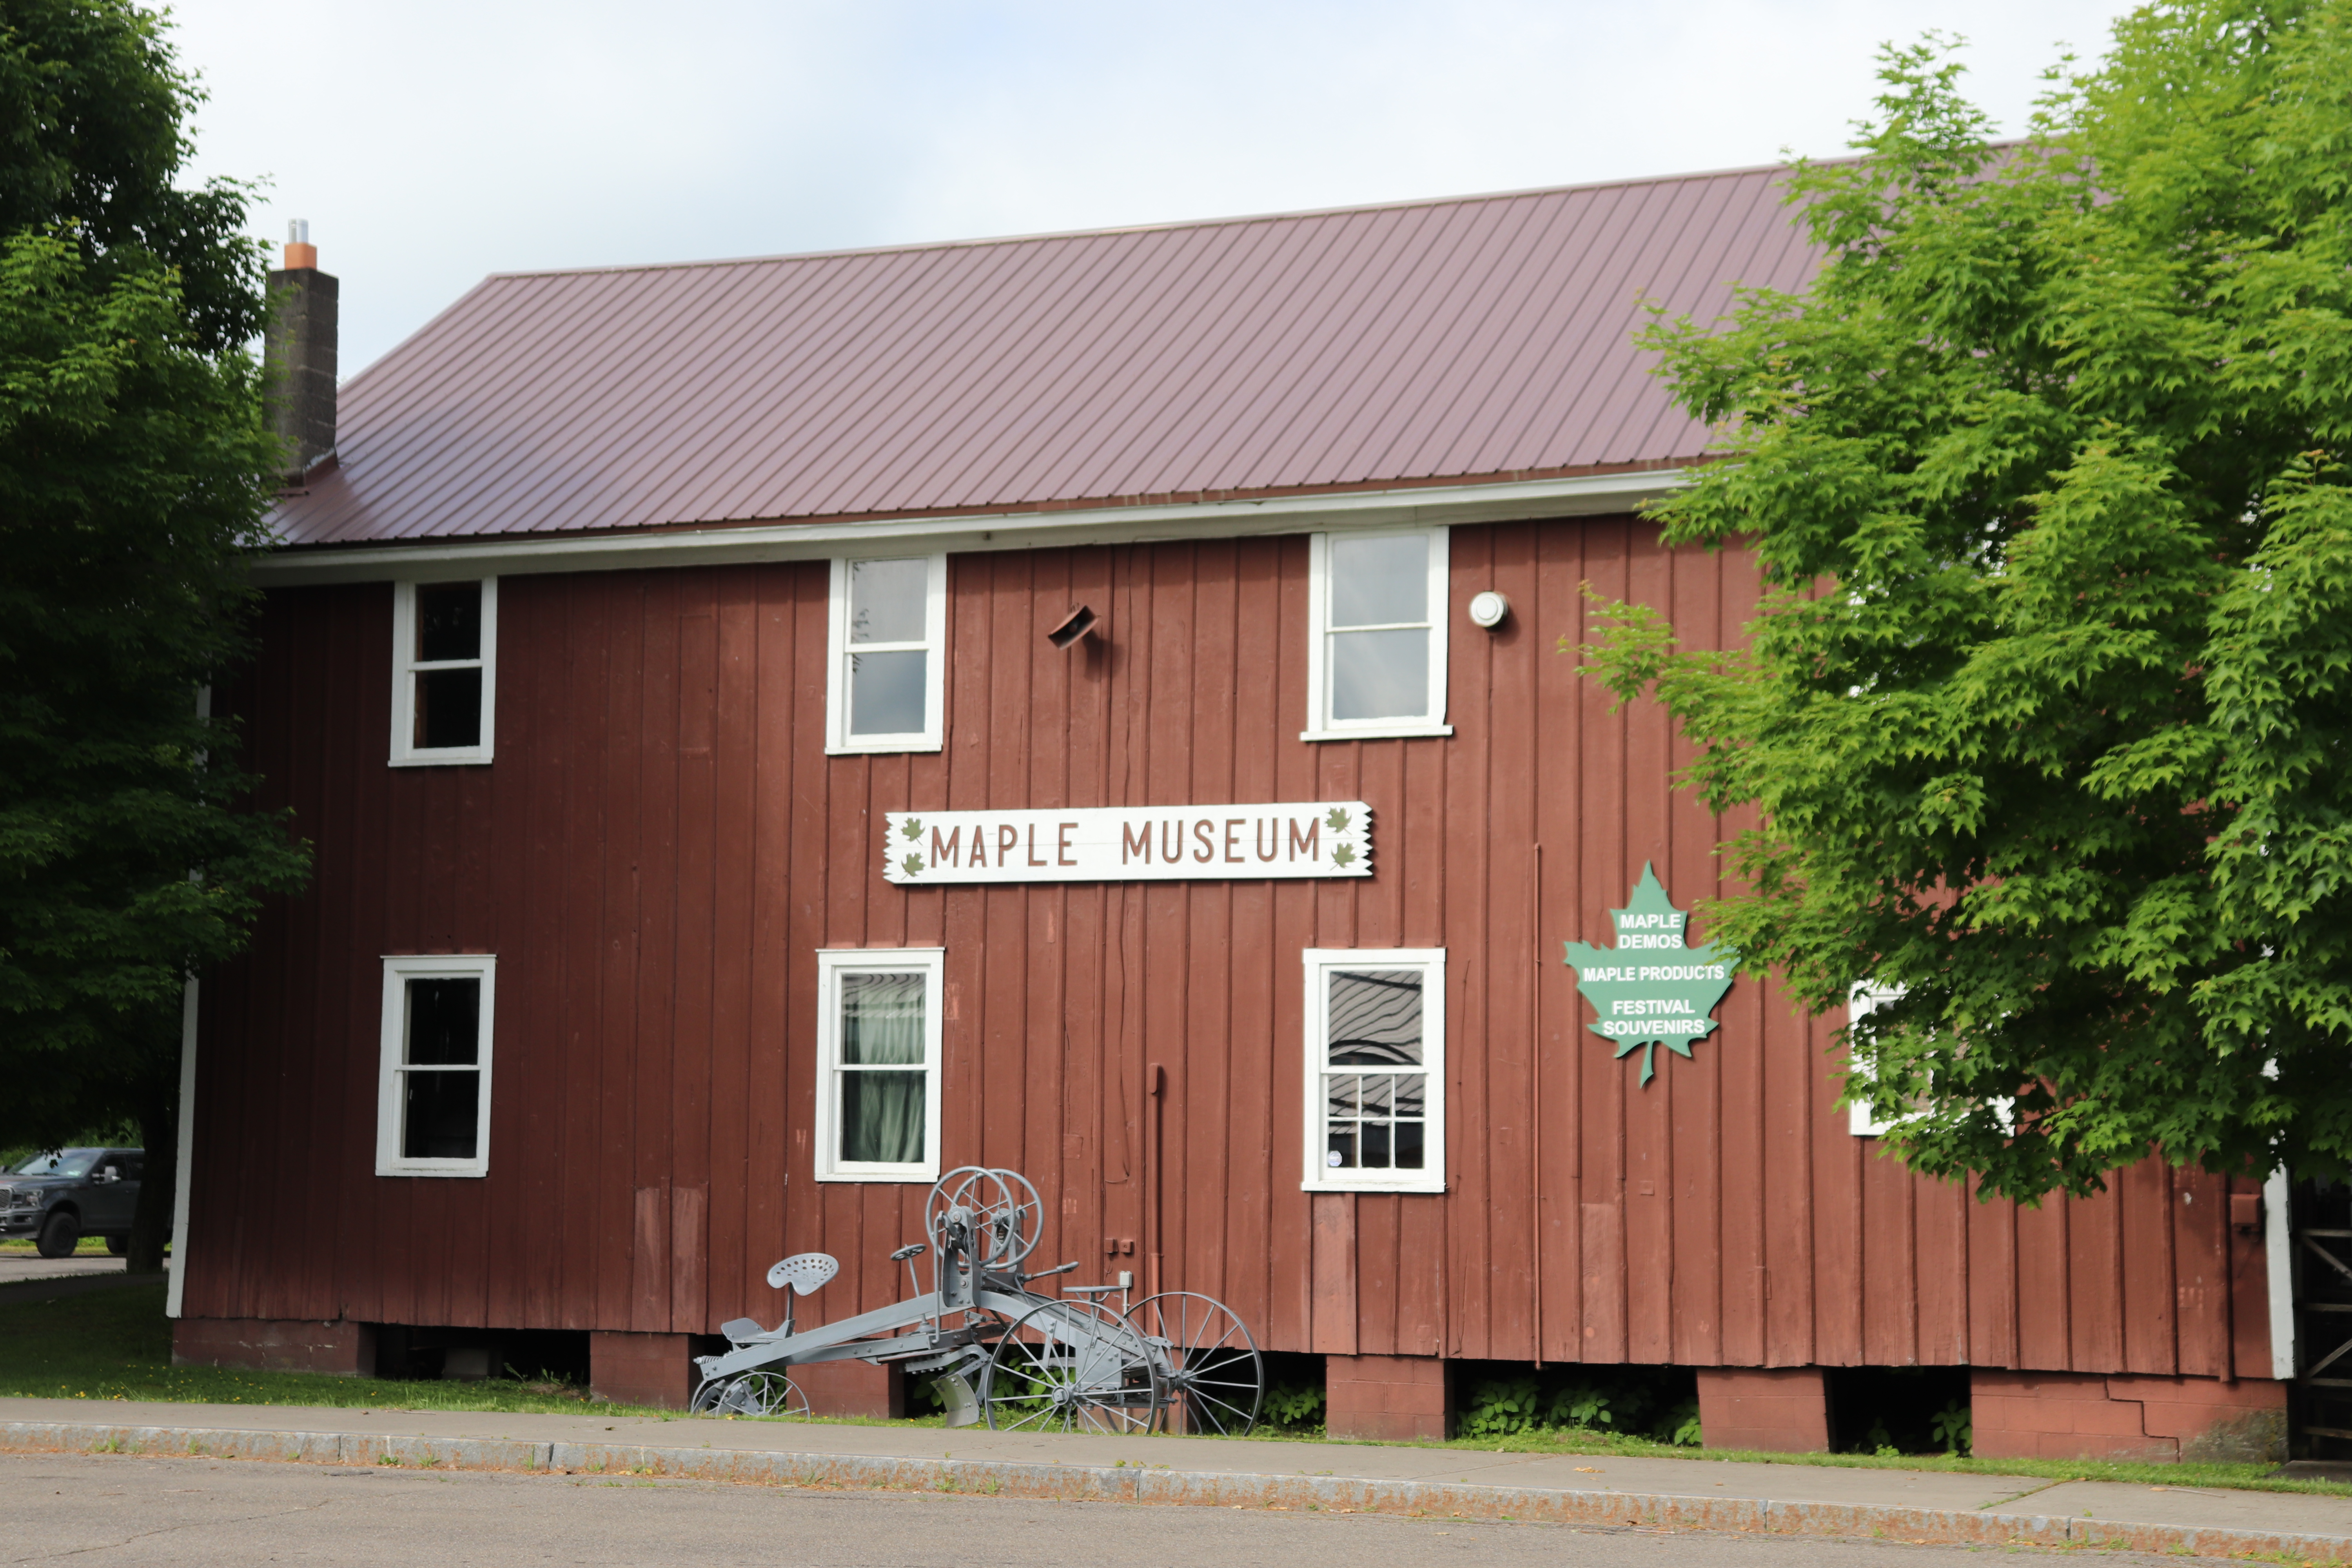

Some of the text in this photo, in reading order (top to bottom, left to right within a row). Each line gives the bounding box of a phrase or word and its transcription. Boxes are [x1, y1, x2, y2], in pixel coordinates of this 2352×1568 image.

[931, 817, 1320, 868] MAPLE MUSEUM
[1621, 914, 1681, 928] MAPLE
[1619, 934, 1682, 949] DEMOS
[1584, 965, 1724, 981] MAPLE PRODUCTS
[1613, 1000, 1695, 1014] FESTIVAL
[1603, 1019, 1705, 1035] SOUVENIRS
